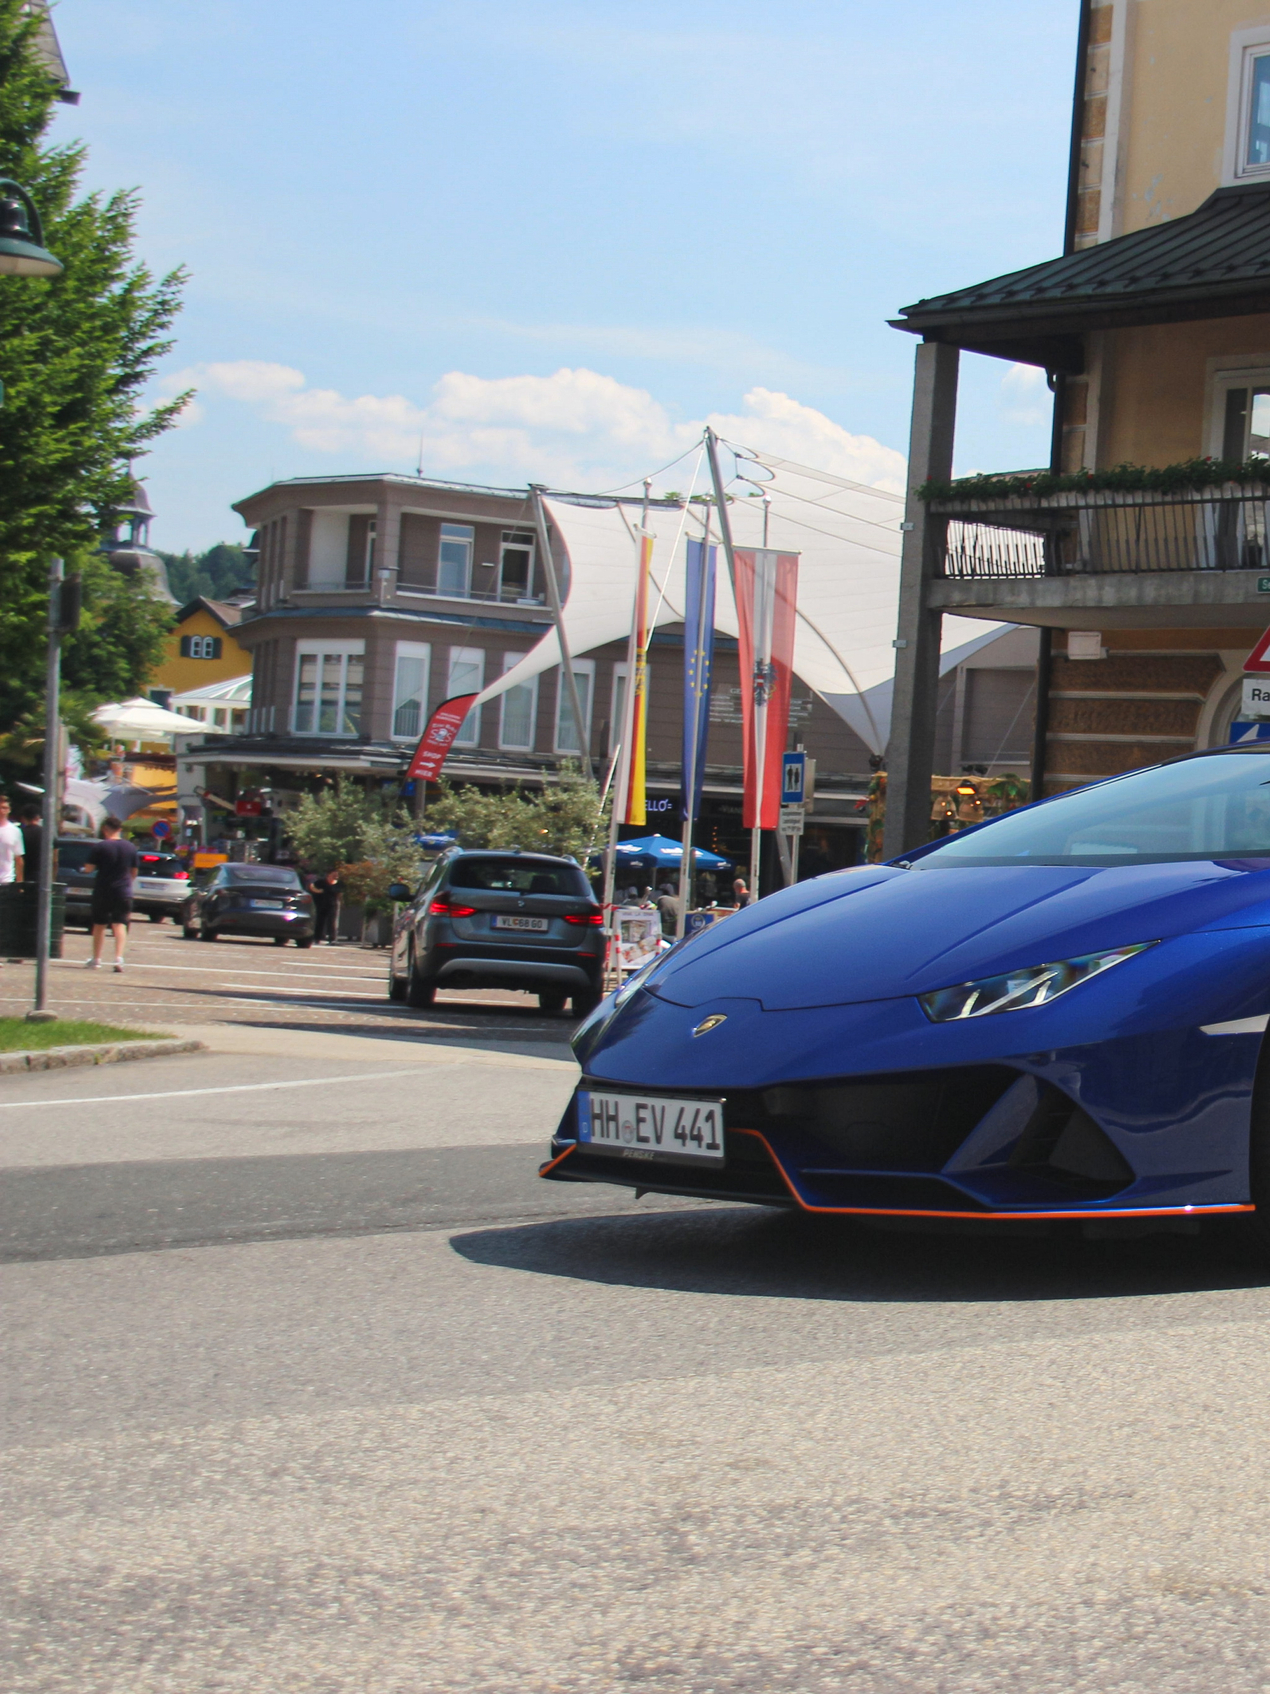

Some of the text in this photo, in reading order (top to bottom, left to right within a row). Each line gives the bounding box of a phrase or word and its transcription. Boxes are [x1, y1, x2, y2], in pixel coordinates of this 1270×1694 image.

[590, 1098, 721, 1151] HH EV 441
[622, 1149, 655, 1161] PENSKE
